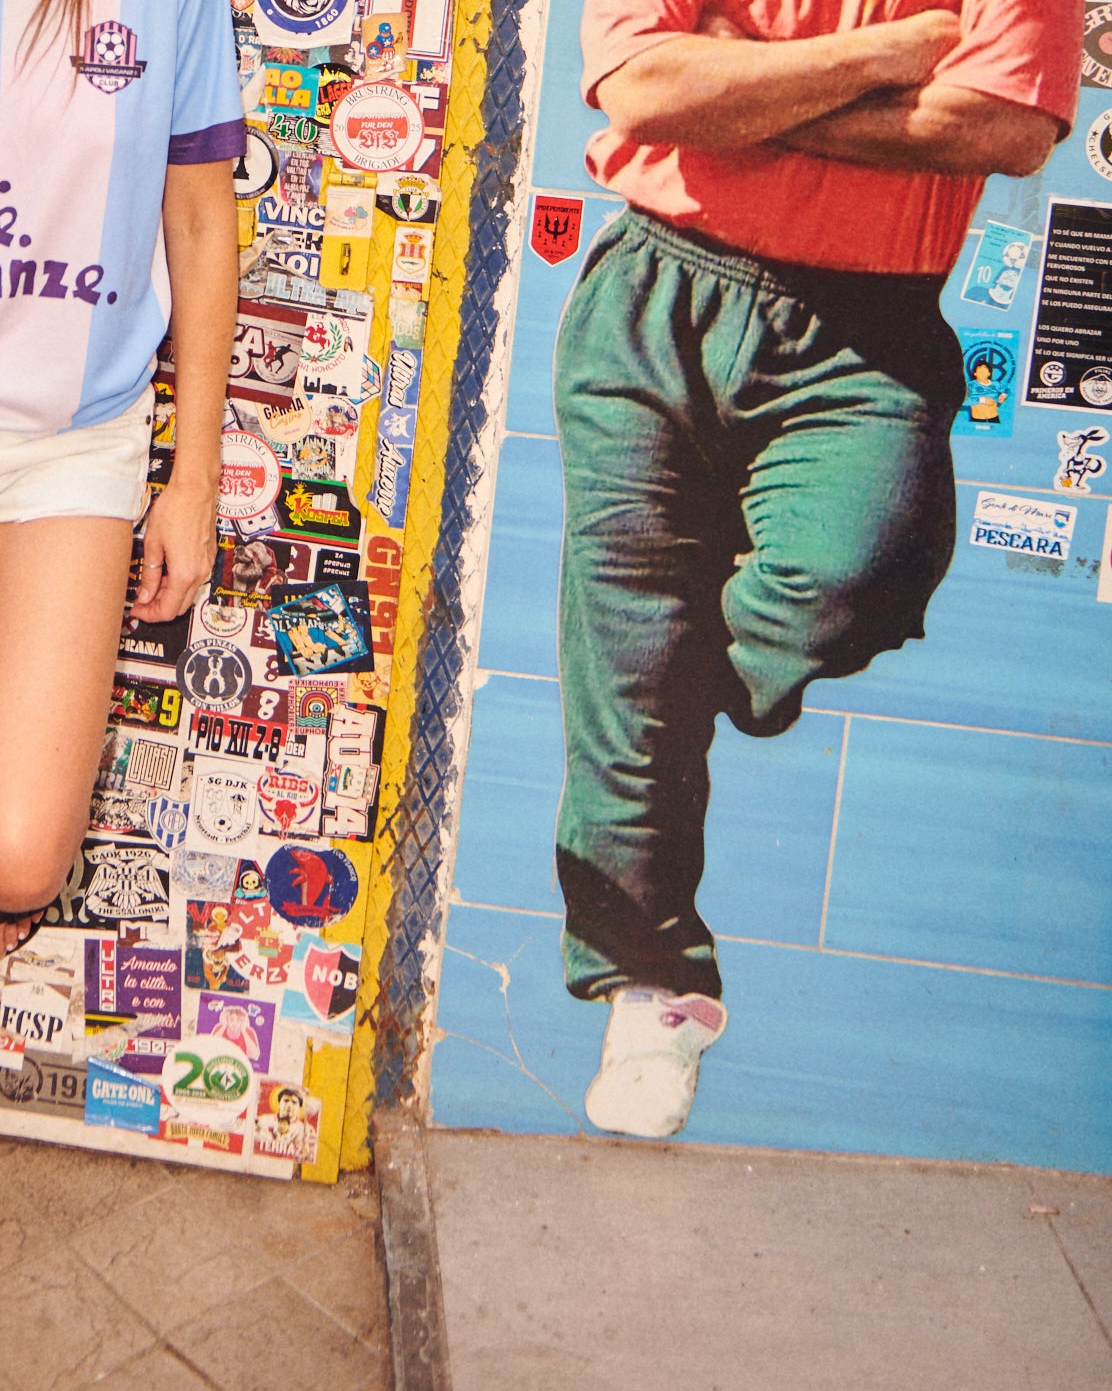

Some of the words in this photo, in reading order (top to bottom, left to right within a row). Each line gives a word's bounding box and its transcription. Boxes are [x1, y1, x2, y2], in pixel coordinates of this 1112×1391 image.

[315, 8, 339, 28] 1860
[346, 85, 409, 108] BRUSTRING
[353, 155, 401, 170] BRIGADE
[1082, 244, 1105, 252] VUELVO
[1058, 254, 1094, 263] ENCUENTRO
[1047, 263, 1085, 271] FERVOROSOS
[1069, 277, 1093, 285] EXISTEN
[1054, 288, 1081, 296] NINGUNA
[1083, 290, 1101, 298] PARTE
[1051, 325, 1073, 333] QUIERO
[1075, 327, 1102, 336] ABRAZAR
[1052, 337, 1065, 345] POR
[975, 527, 1063, 556] PESCARA
[207, 776, 222, 785] SG
[225, 780, 248, 790] DJK
[269, 774, 308, 793] RIBS
[98, 905, 166, 915] THESSALONIKI
[121, 956, 177, 973] Amando
[312, 964, 358, 990] NOB
[143, 997, 166, 1008] con
[92, 1079, 127, 1099] GATE
[128, 1084, 155, 1105] ONE
